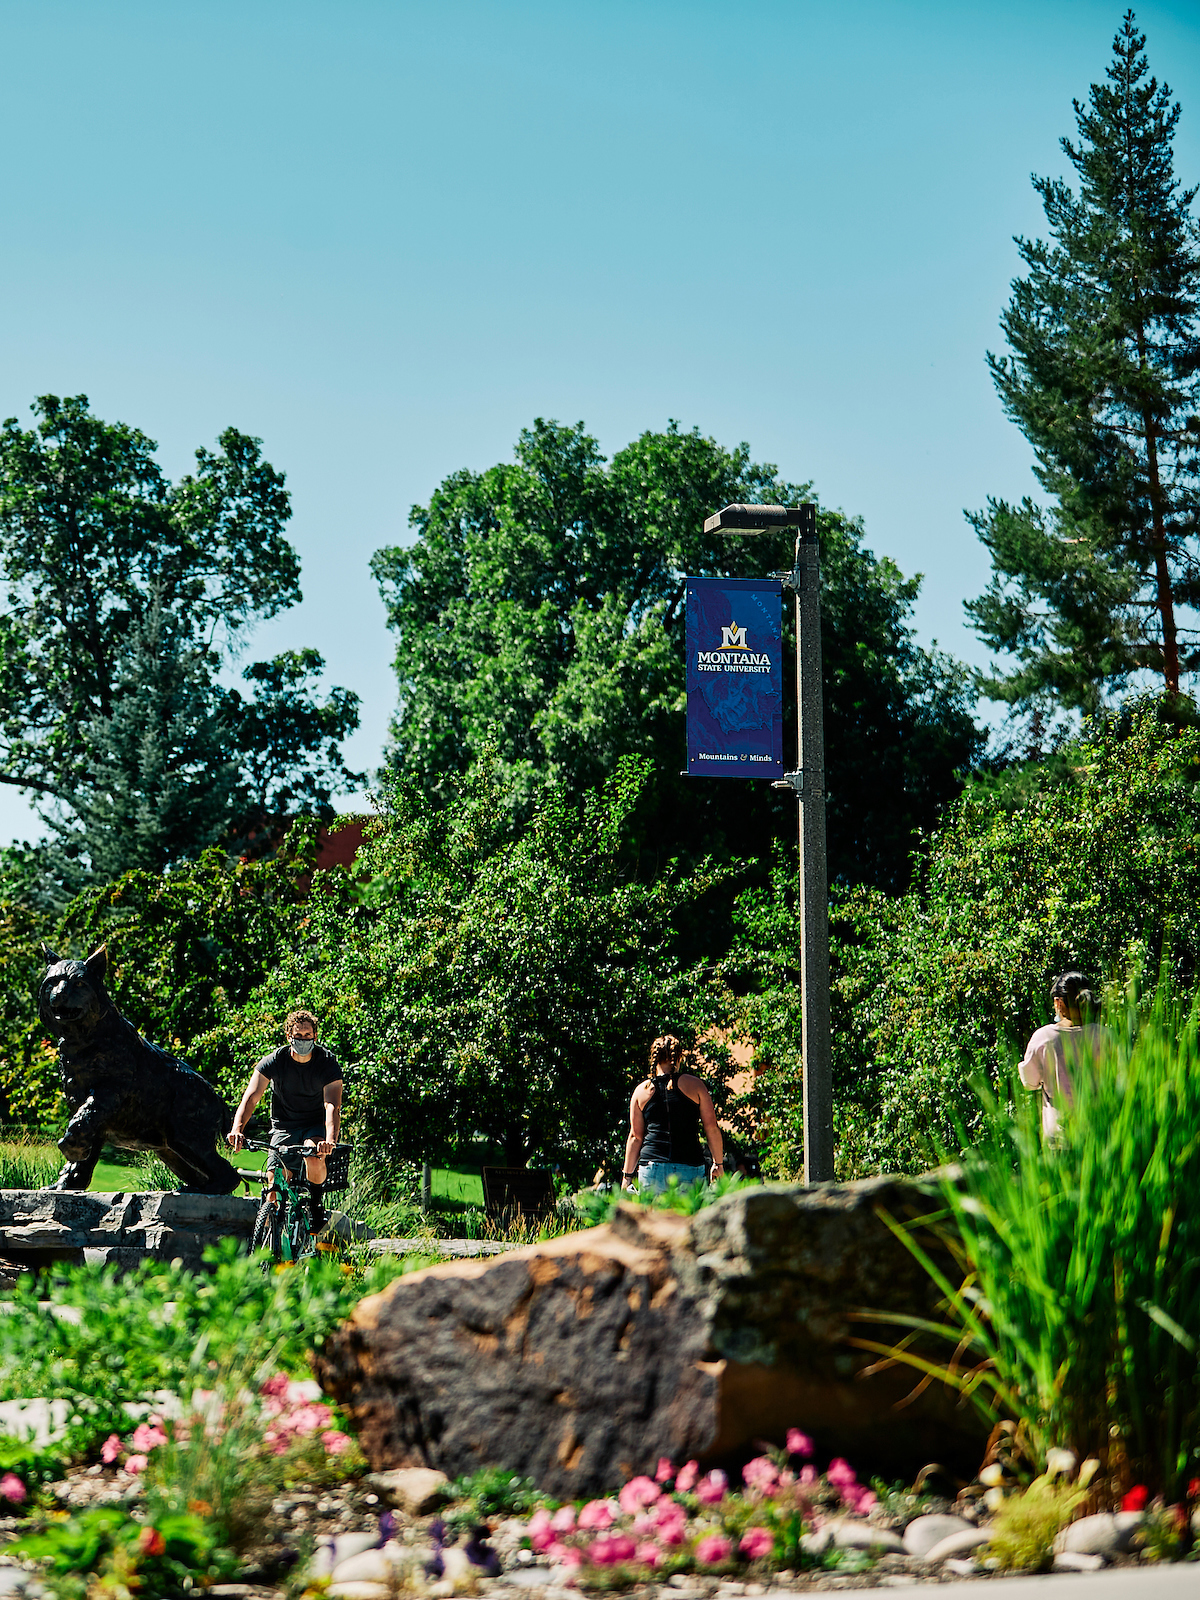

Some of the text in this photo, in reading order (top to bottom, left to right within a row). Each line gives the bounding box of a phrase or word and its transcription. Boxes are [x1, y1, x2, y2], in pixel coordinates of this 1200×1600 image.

[721, 626, 747, 648] M
[698, 652, 771, 665] MONTANA
[724, 665, 771, 673] UNIVERSITY
[699, 753, 738, 761] Mountains
